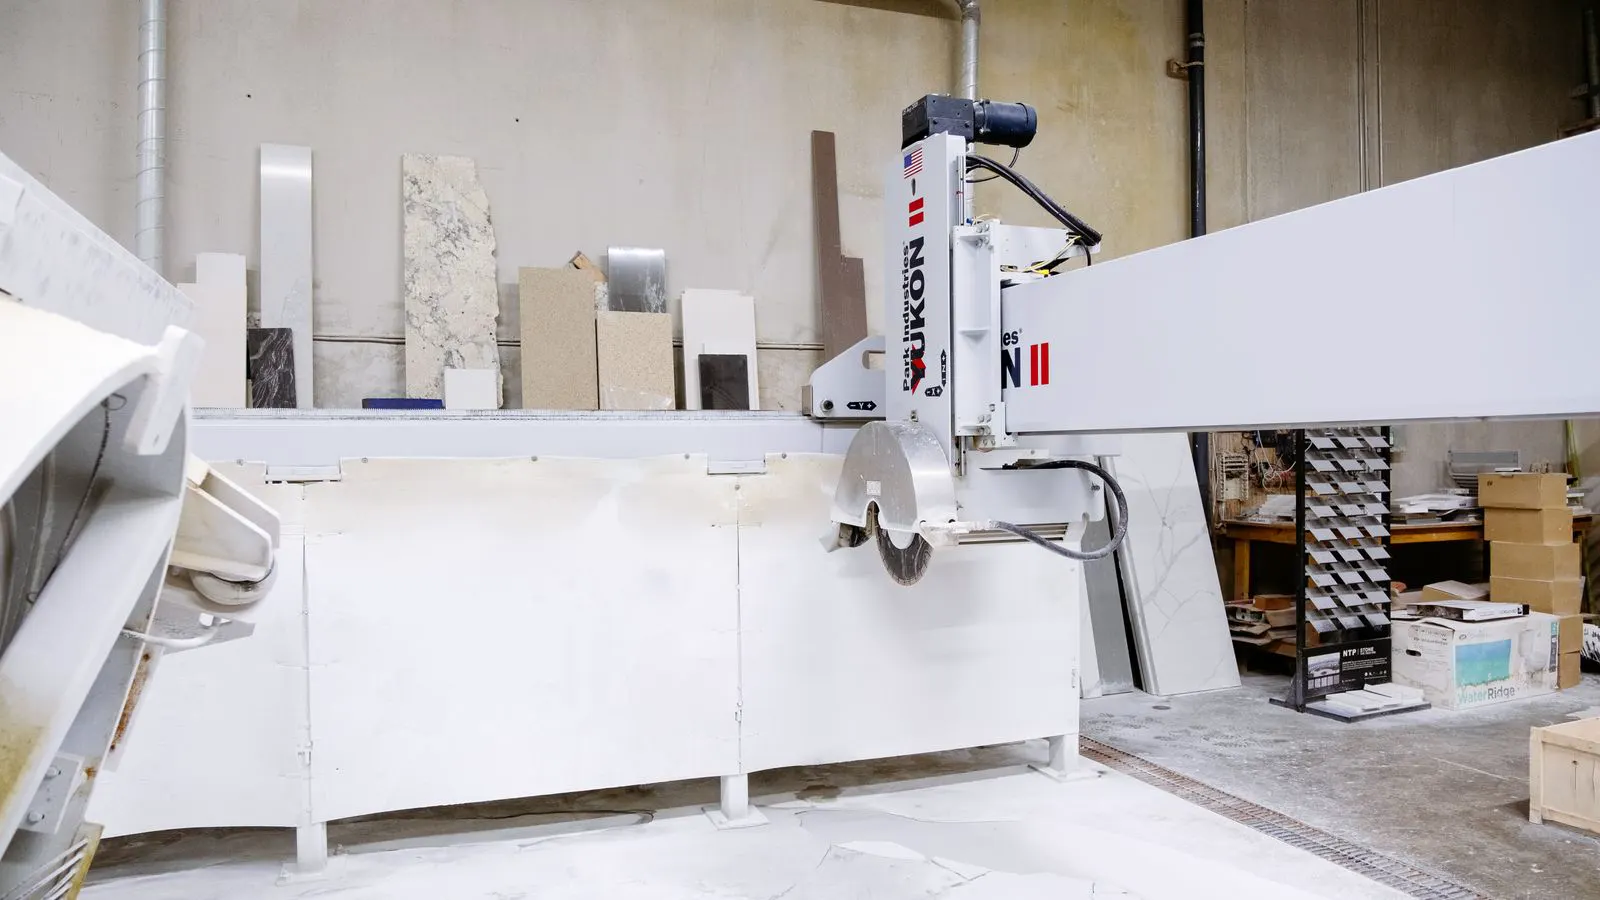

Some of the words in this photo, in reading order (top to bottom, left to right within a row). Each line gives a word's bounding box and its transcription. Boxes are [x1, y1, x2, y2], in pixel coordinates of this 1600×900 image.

[902, 244, 910, 342] Industries
[909, 235, 926, 395] YUKON
[1342, 649, 1356, 657] NTP
